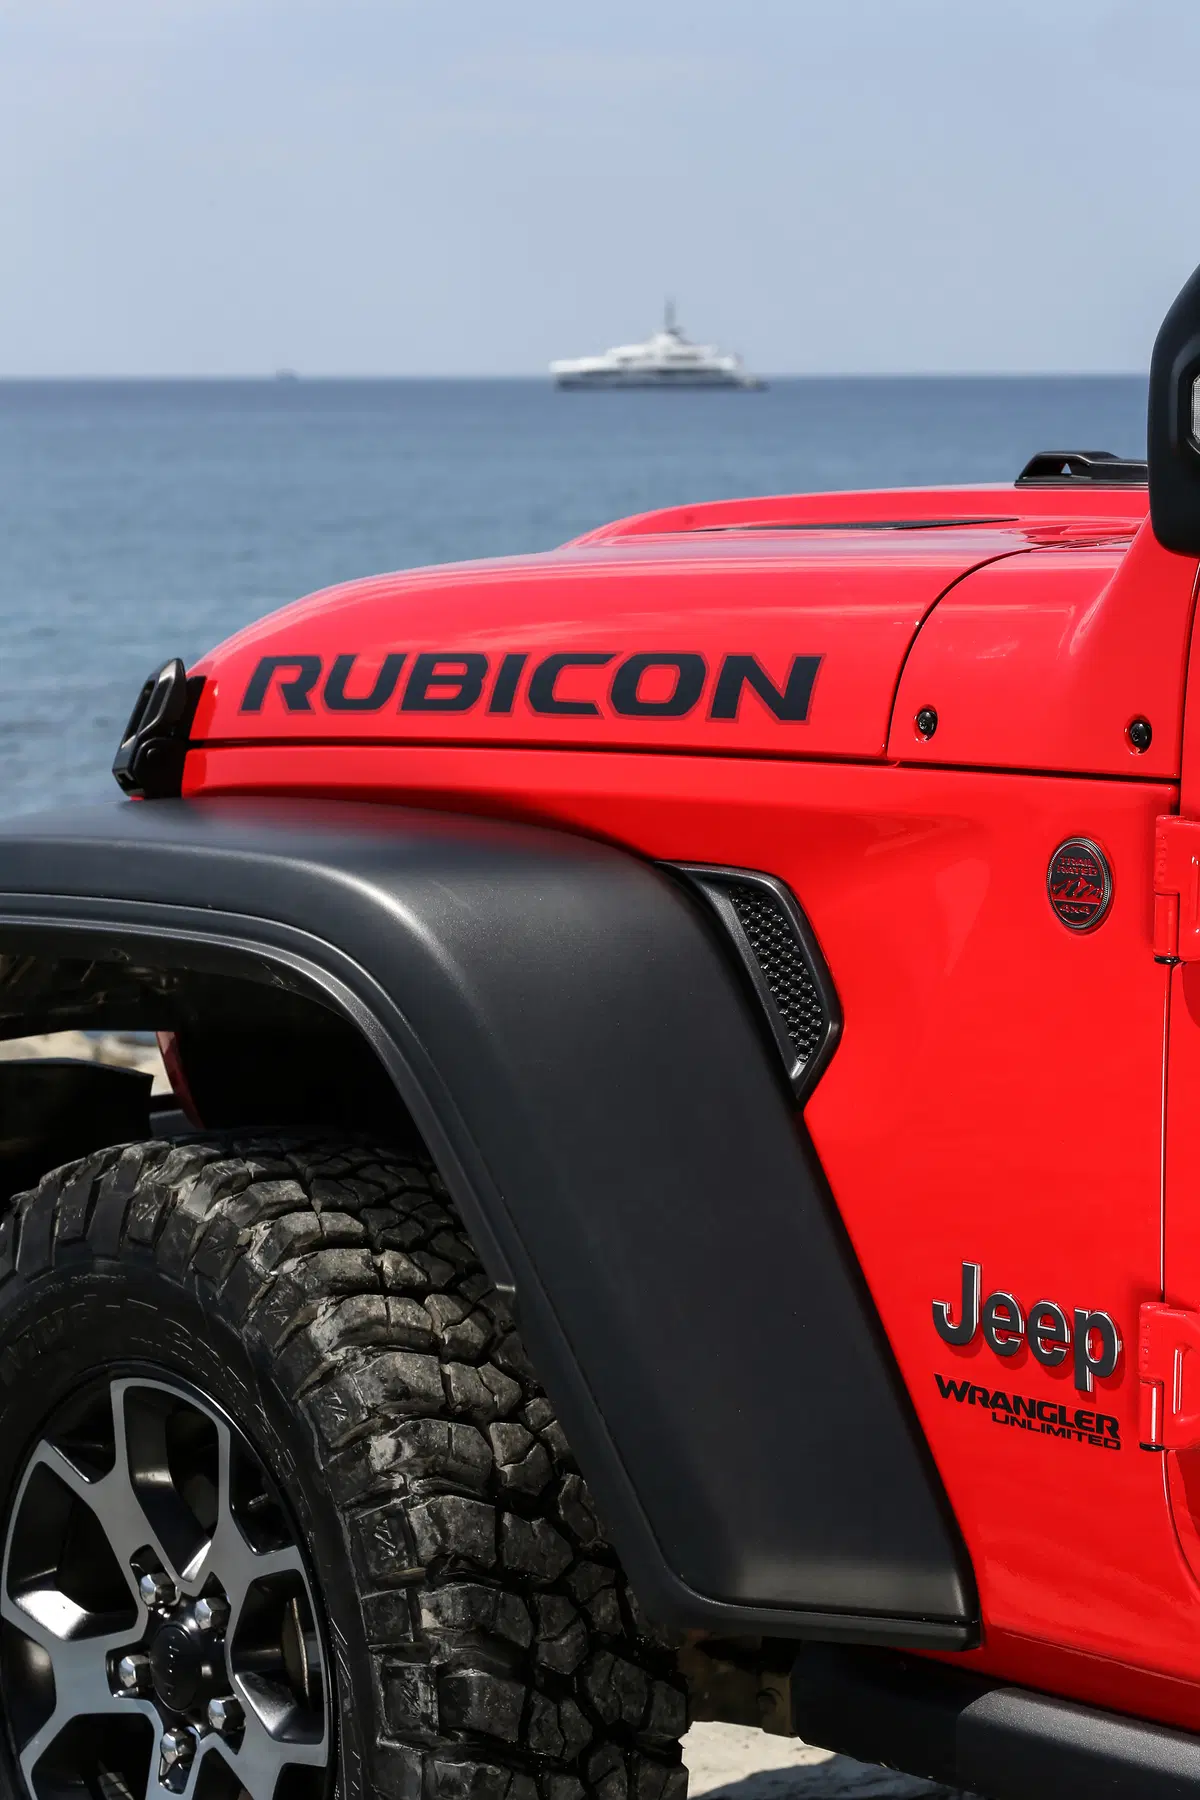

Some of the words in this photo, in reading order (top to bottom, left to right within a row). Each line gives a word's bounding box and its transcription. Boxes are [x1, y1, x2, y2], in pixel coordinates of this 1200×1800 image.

[239, 652, 824, 723] RUBICON
[1057, 865, 1098, 877] RATED
[1060, 856, 1095, 868] TRAIL
[932, 1261, 1121, 1392] Jeep
[934, 1373, 1120, 1440] WRANGLER
[991, 1411, 1121, 1451] UNLIMITED
